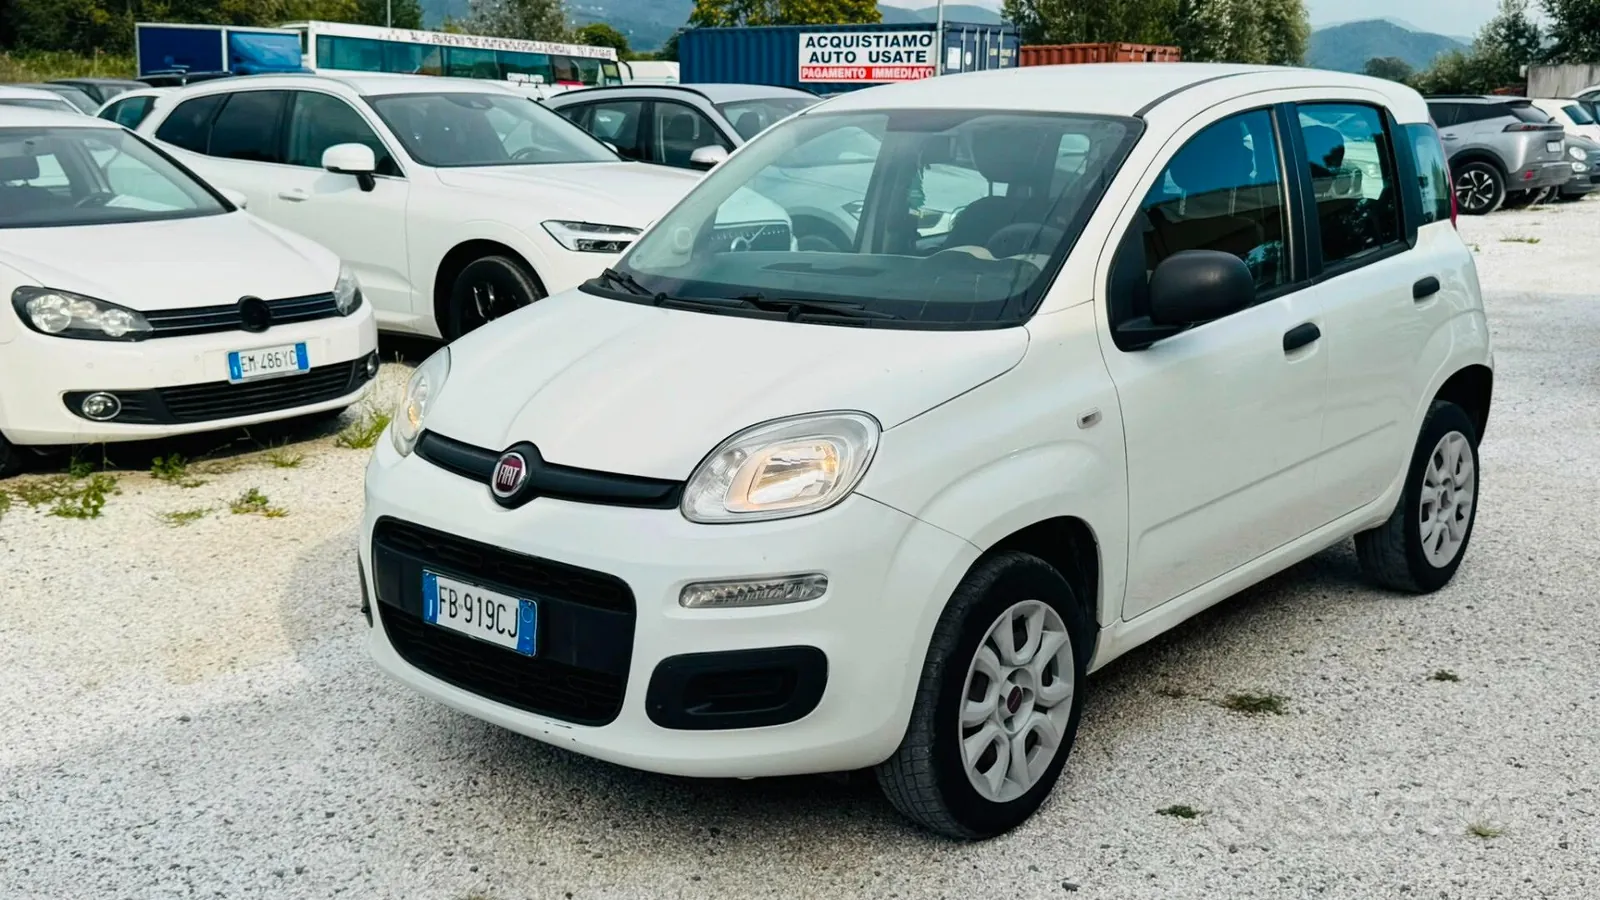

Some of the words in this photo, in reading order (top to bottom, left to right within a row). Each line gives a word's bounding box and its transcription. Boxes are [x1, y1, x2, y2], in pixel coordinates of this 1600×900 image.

[805, 34, 933, 49] ACQUISTIAMO
[809, 51, 857, 63] AUTO
[868, 50, 927, 63] USATE
[802, 67, 867, 79] PAGAMENTO
[871, 67, 934, 80] IMMEDIATO
[497, 464, 520, 486] FIAT
